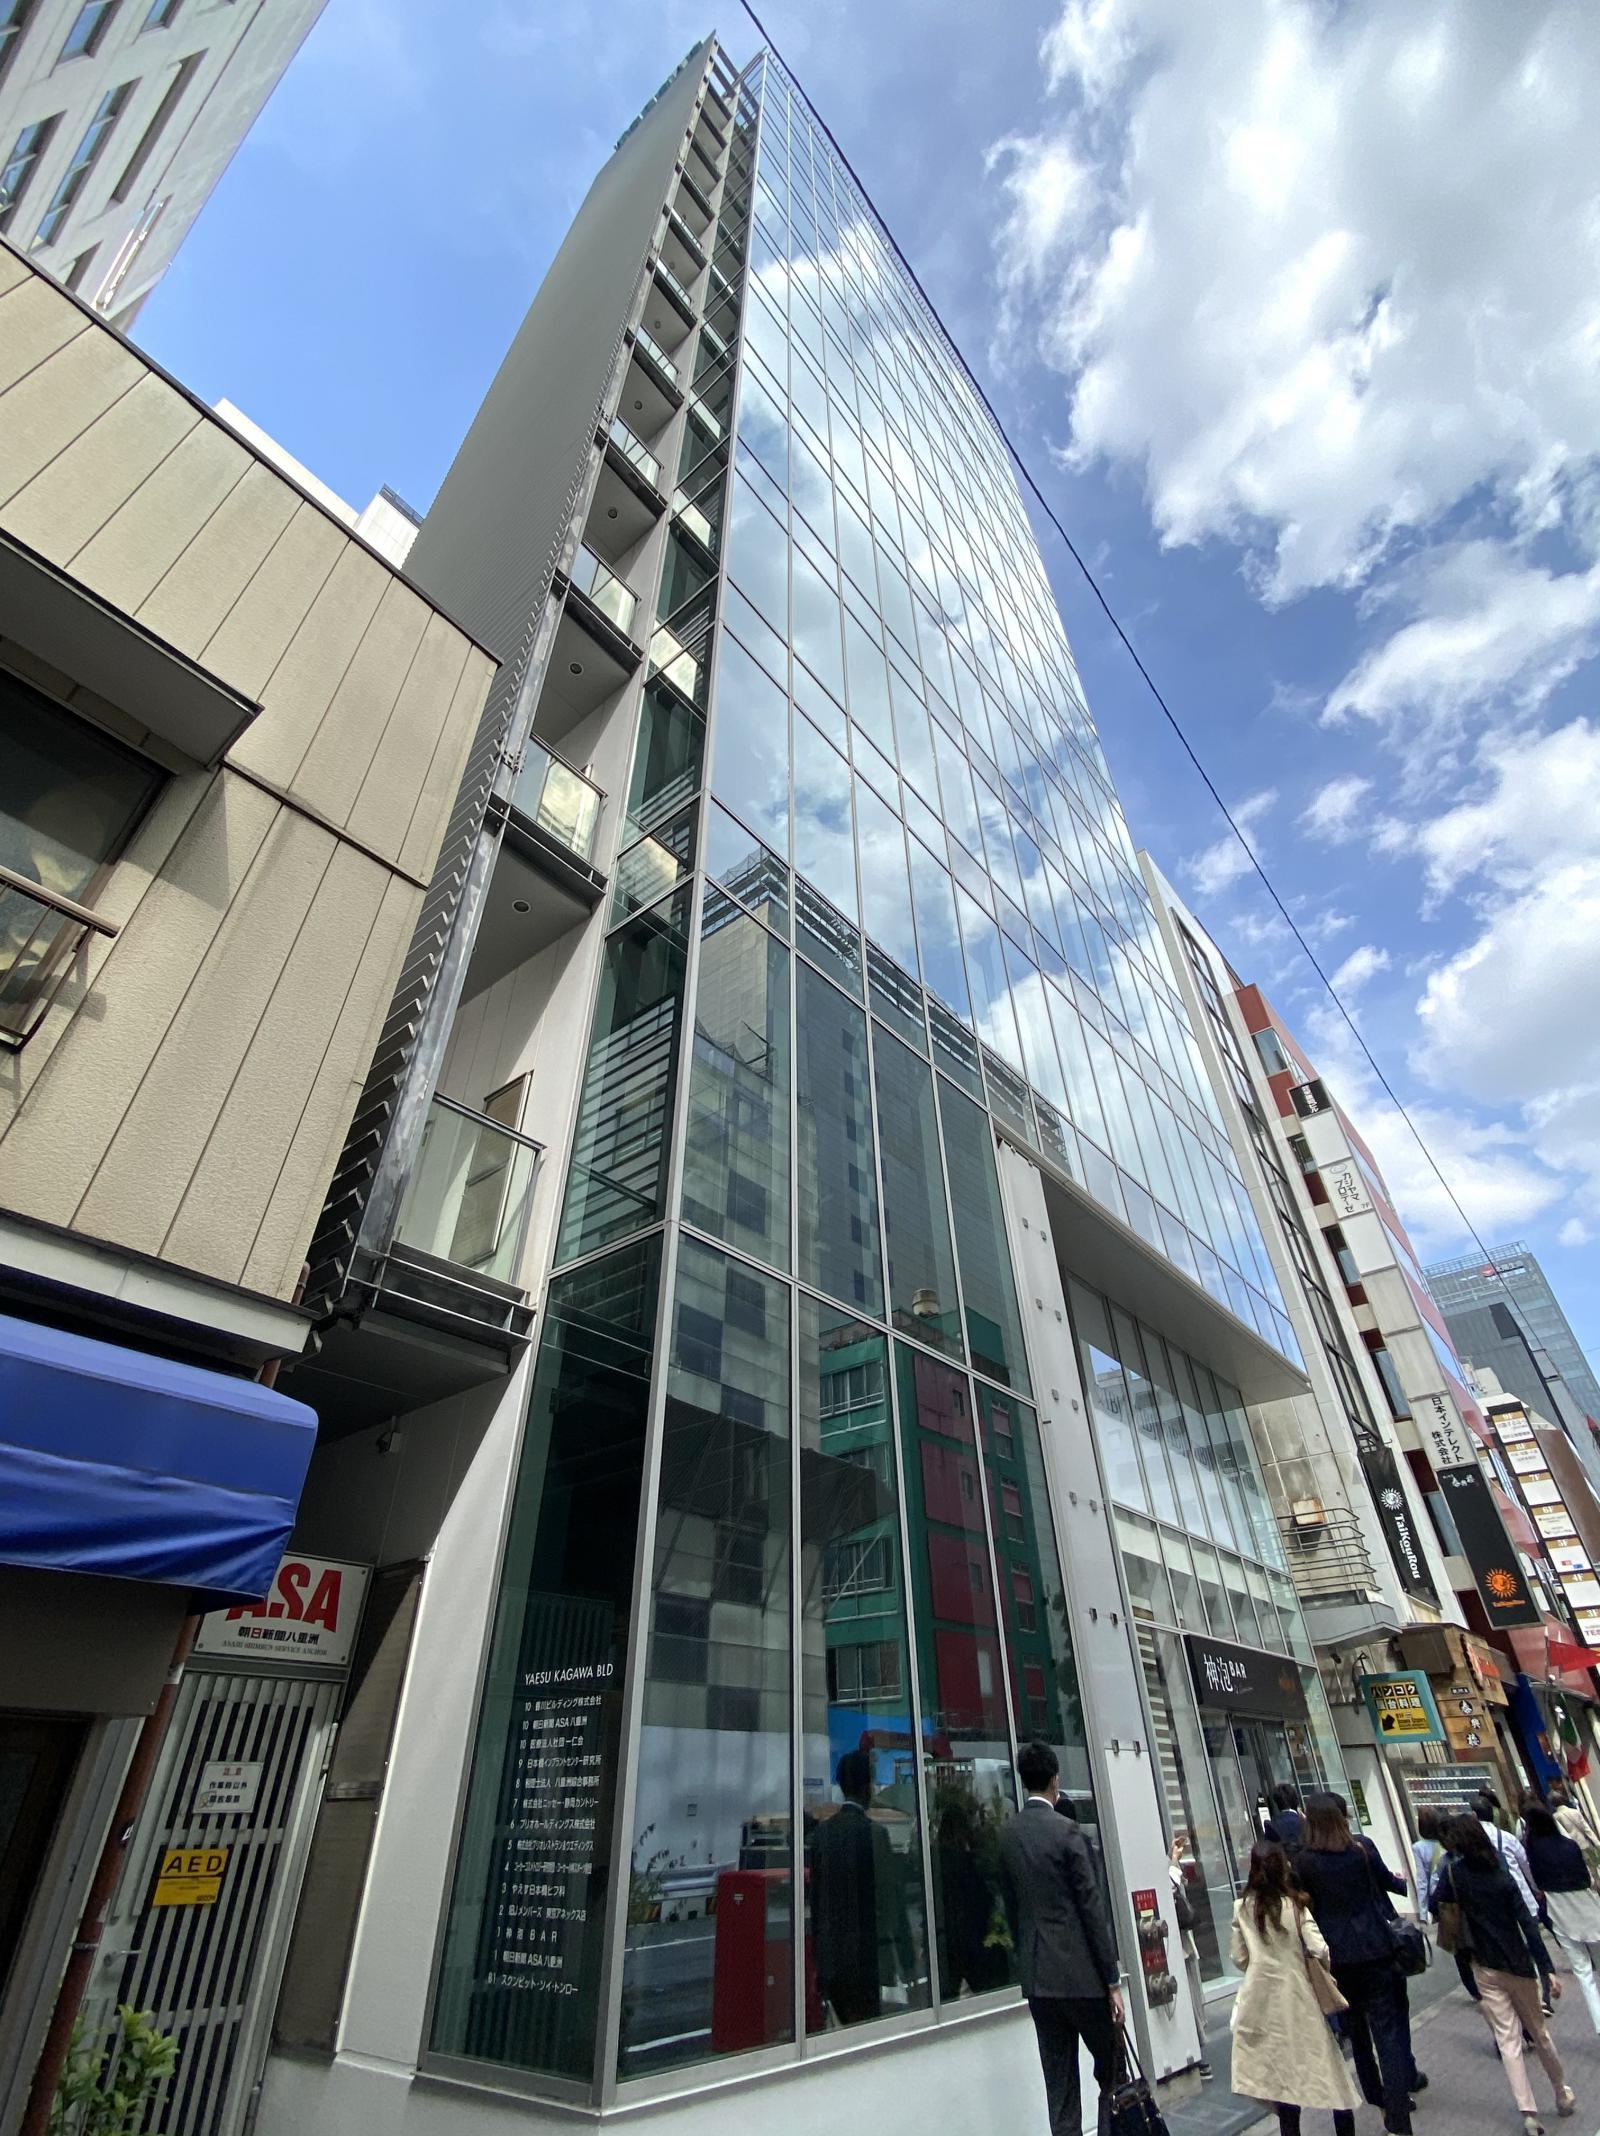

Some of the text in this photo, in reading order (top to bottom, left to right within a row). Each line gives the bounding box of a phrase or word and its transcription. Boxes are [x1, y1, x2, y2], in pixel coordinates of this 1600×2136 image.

[1431, 1396, 1464, 1462] 日本インテレクト
[1431, 1431, 1453, 1464] 株式会社
[525, 1663, 613, 1686] YAESU KAGAWA BLD
[165, 1855, 223, 1873] AED
